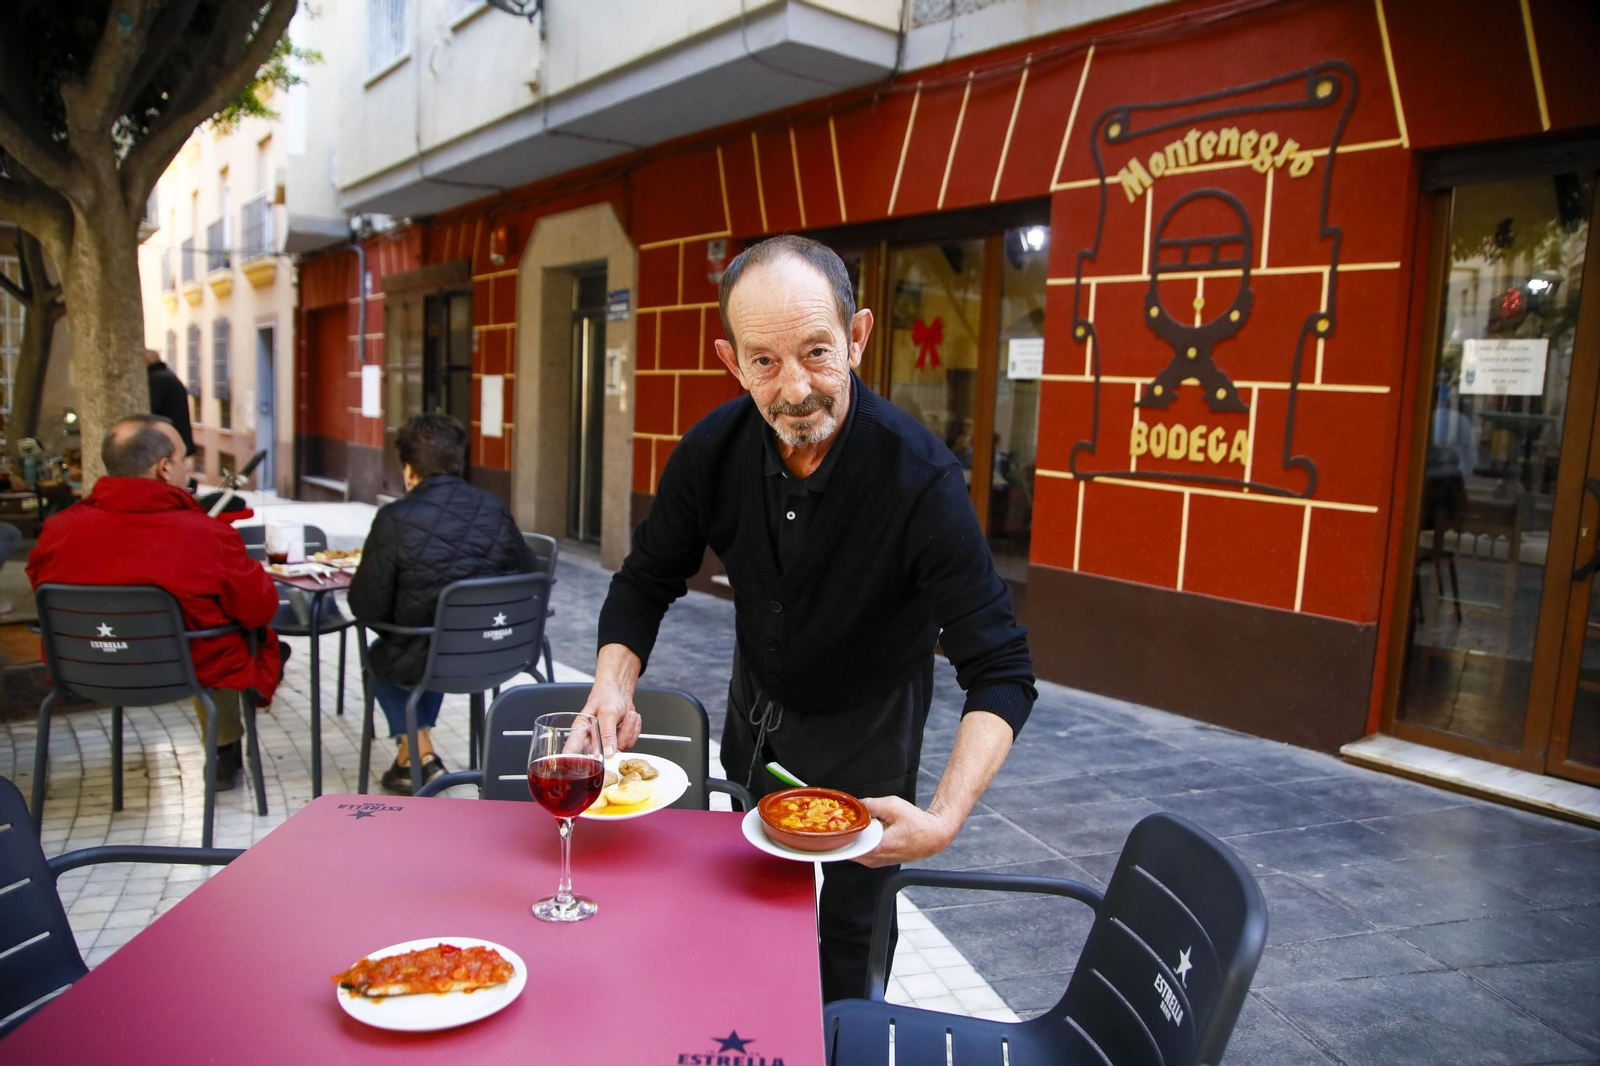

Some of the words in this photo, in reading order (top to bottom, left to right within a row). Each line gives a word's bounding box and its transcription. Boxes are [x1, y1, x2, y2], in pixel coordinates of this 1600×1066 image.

[1117, 127, 1314, 204] Montenegro
[1129, 421, 1249, 466] BODEGA
[90, 641, 128, 649] ESTRELLA
[1154, 973, 1183, 1026] ESTRELLA
[678, 1053, 786, 1066] ESTRELLA
